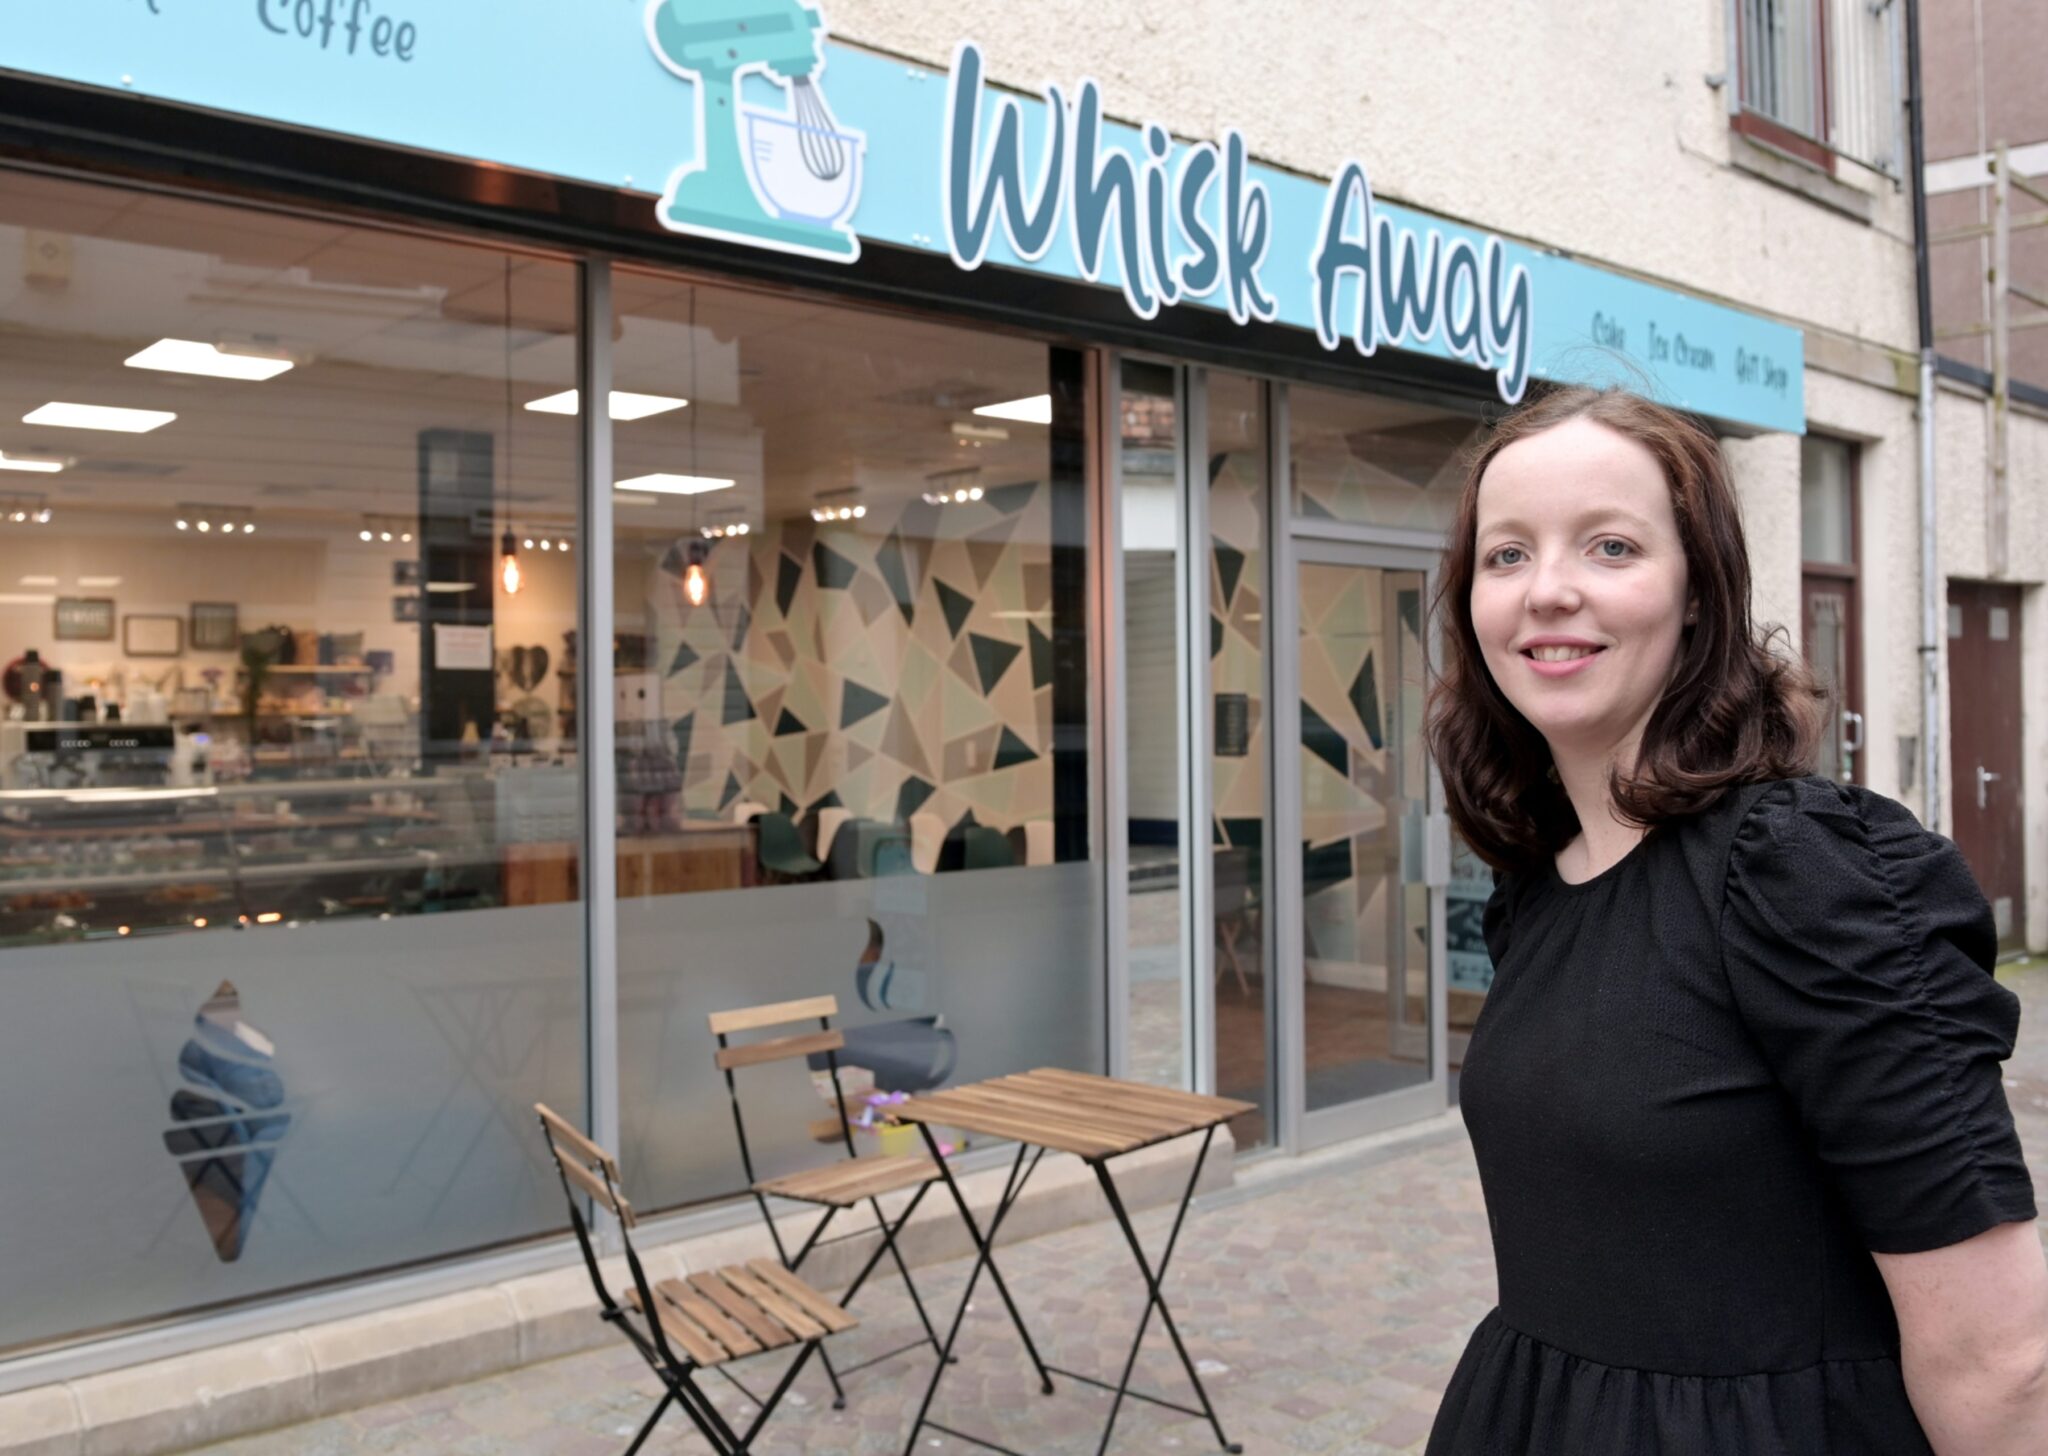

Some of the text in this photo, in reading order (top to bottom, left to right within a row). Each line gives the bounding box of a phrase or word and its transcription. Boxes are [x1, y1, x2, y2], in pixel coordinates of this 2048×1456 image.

[257, 0, 417, 62] Coffee
[947, 42, 1530, 400] Whisk Away
